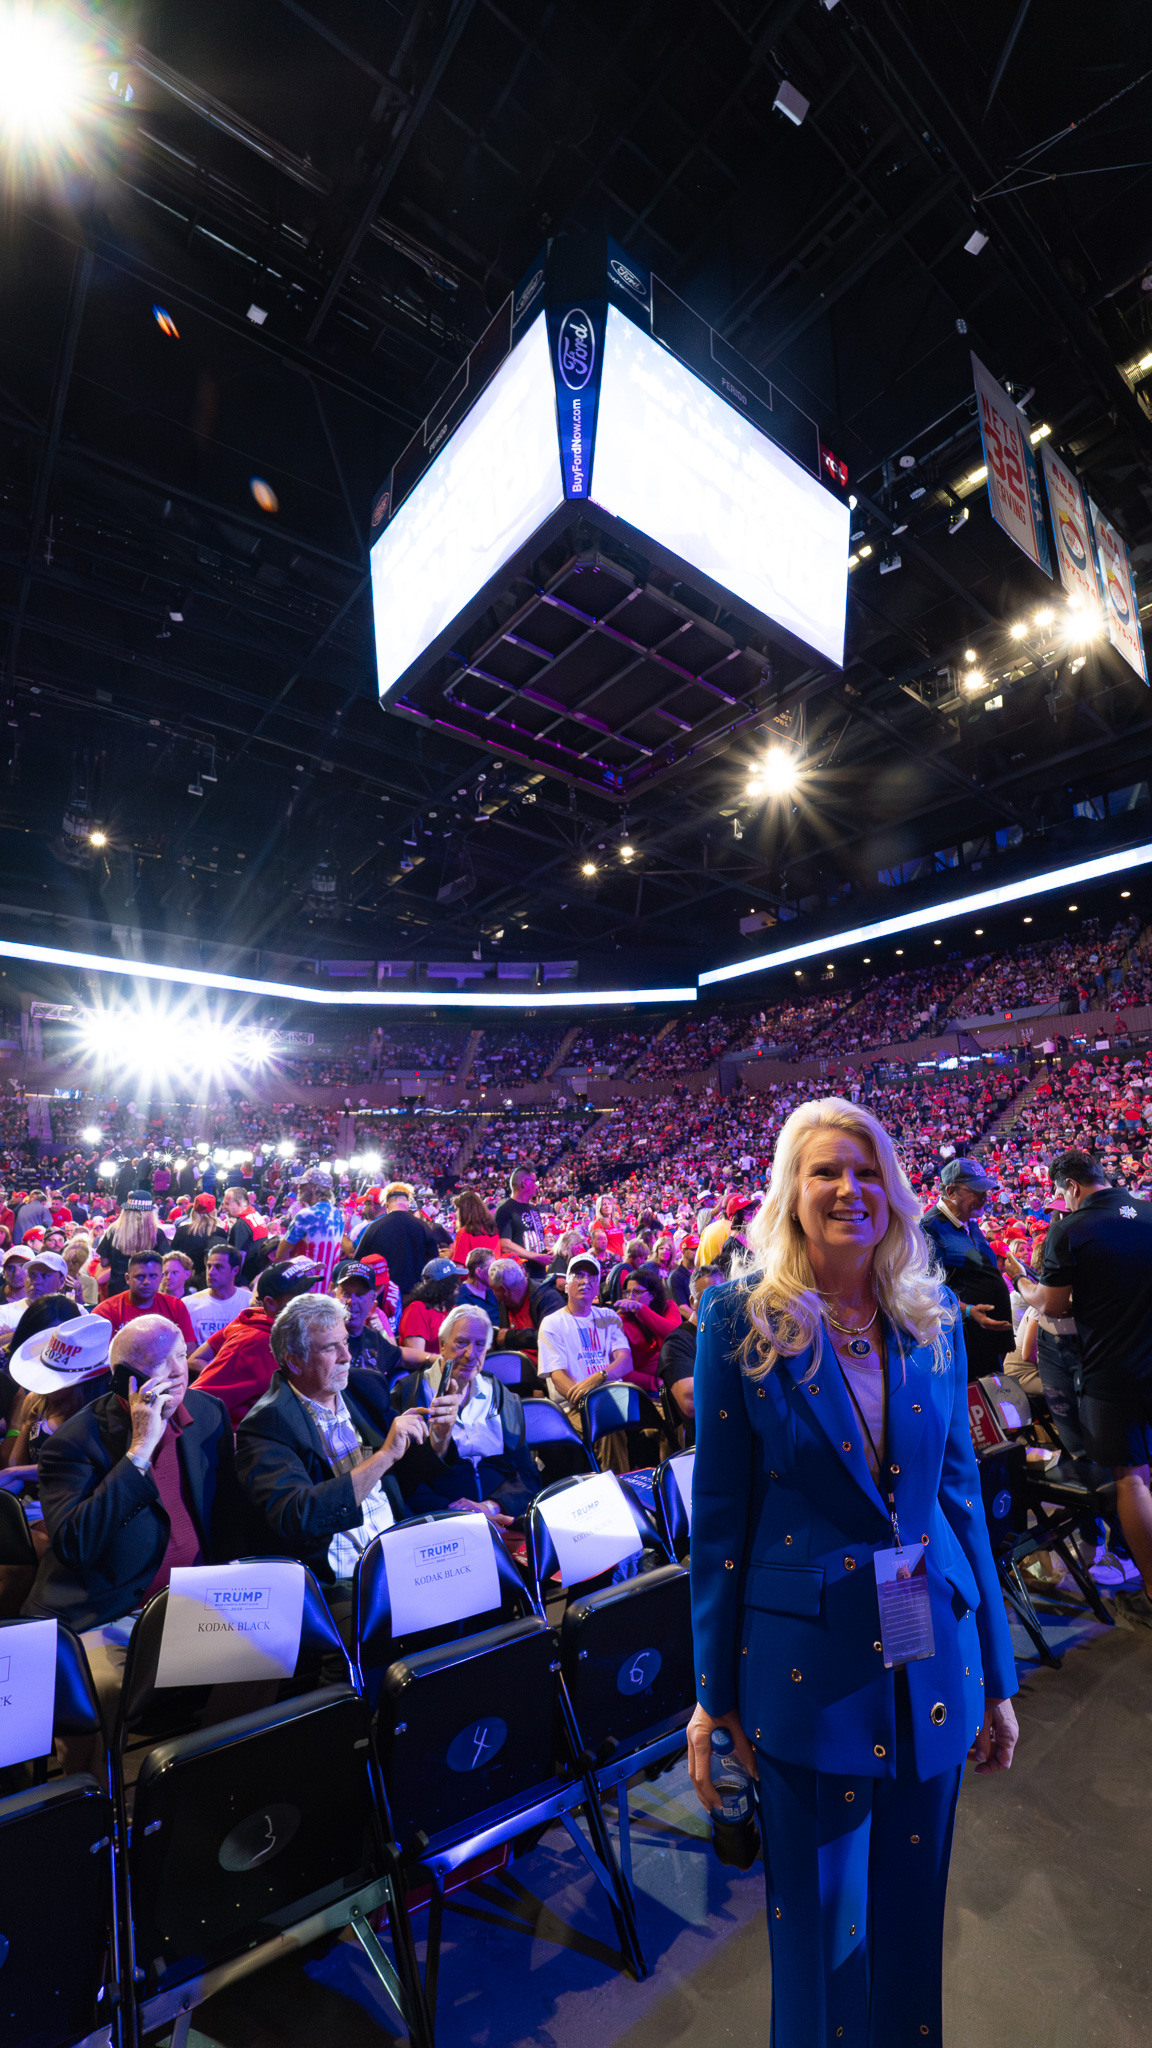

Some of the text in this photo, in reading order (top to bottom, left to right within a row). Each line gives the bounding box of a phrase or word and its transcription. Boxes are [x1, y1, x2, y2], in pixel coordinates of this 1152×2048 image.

[562, 323, 588, 375] Ford
[981, 391, 1019, 456] NETS
[571, 399, 585, 493] BuyFordNow.com
[822, 452, 846, 481] TCL
[984, 421, 1026, 505] 32
[1052, 462, 1076, 500] ABA
[996, 480, 1026, 526] ERVING
[1100, 525, 1120, 557] ABA
[200, 1322, 227, 1331] TRU
[571, 1500, 600, 1519] TRUMP
[420, 1542, 459, 1559] TRUMP
[414, 1565, 471, 1586] KODAK BLACK
[213, 1591, 263, 1603] TRUMP
[198, 1620, 270, 1632] KODAK BLACK
[629, 1652, 650, 1685] 6
[473, 1725, 491, 1769] 4
